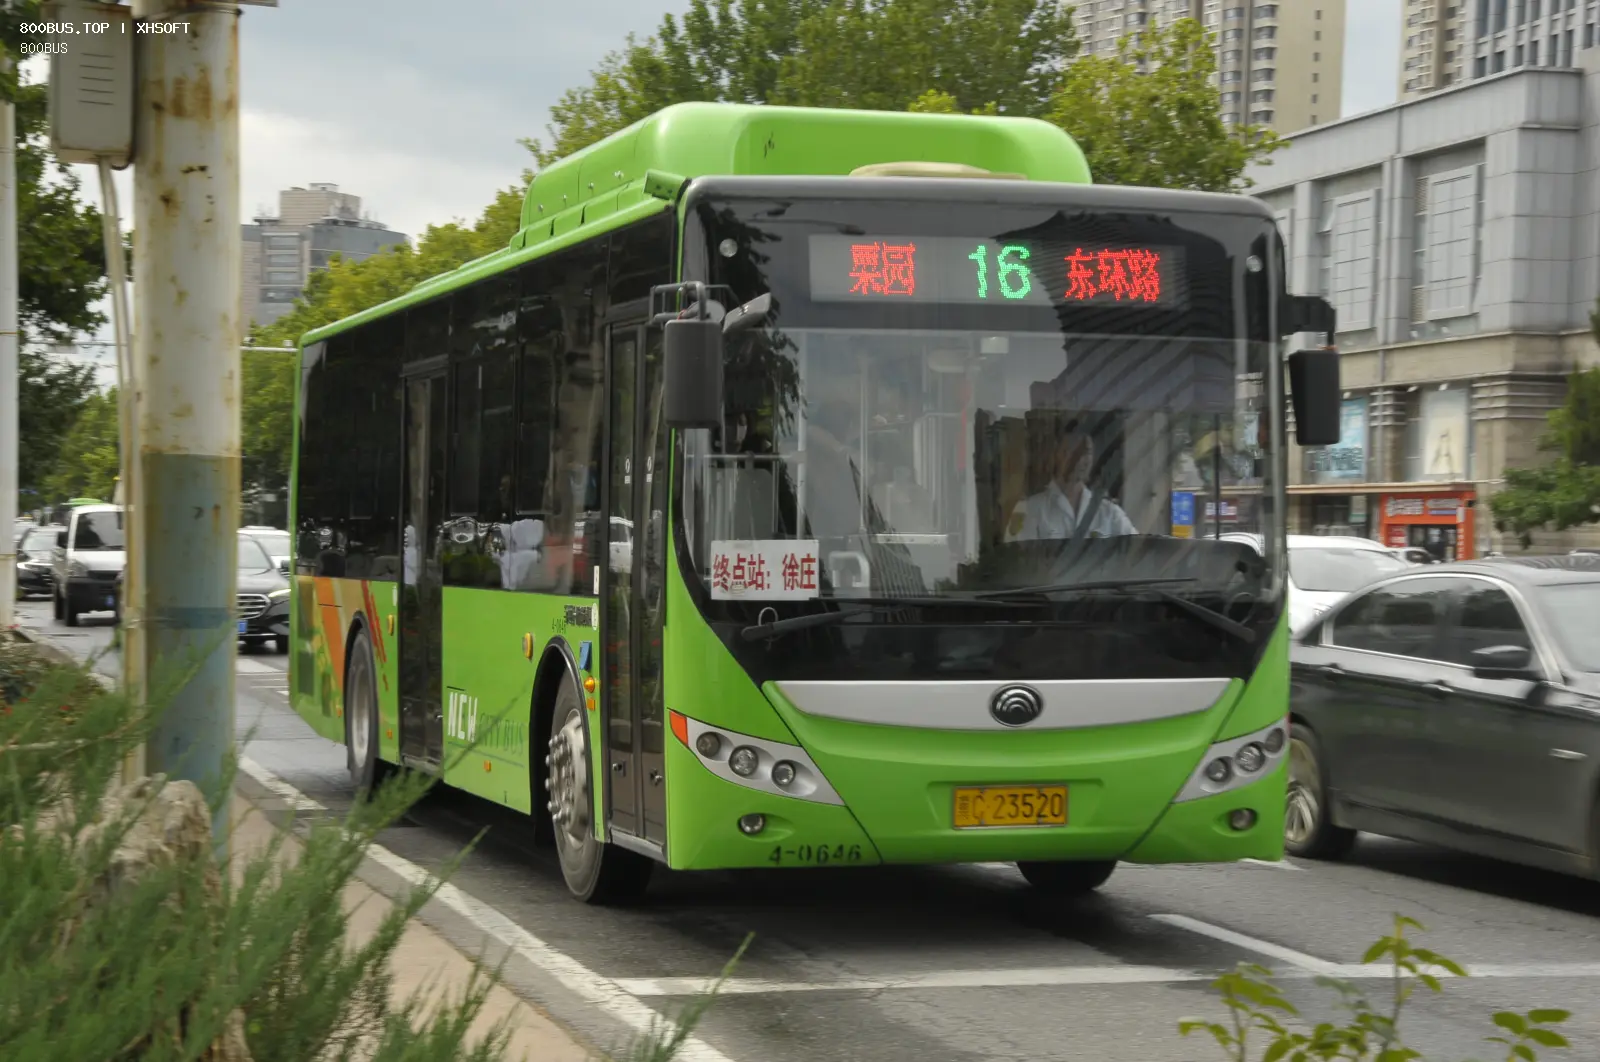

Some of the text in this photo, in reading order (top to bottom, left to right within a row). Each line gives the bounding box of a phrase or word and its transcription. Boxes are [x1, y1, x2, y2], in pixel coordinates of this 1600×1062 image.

[968, 244, 1032, 300] 16
[1064, 247, 1161, 303] 东环路
[768, 844, 861, 866] 4-0646
